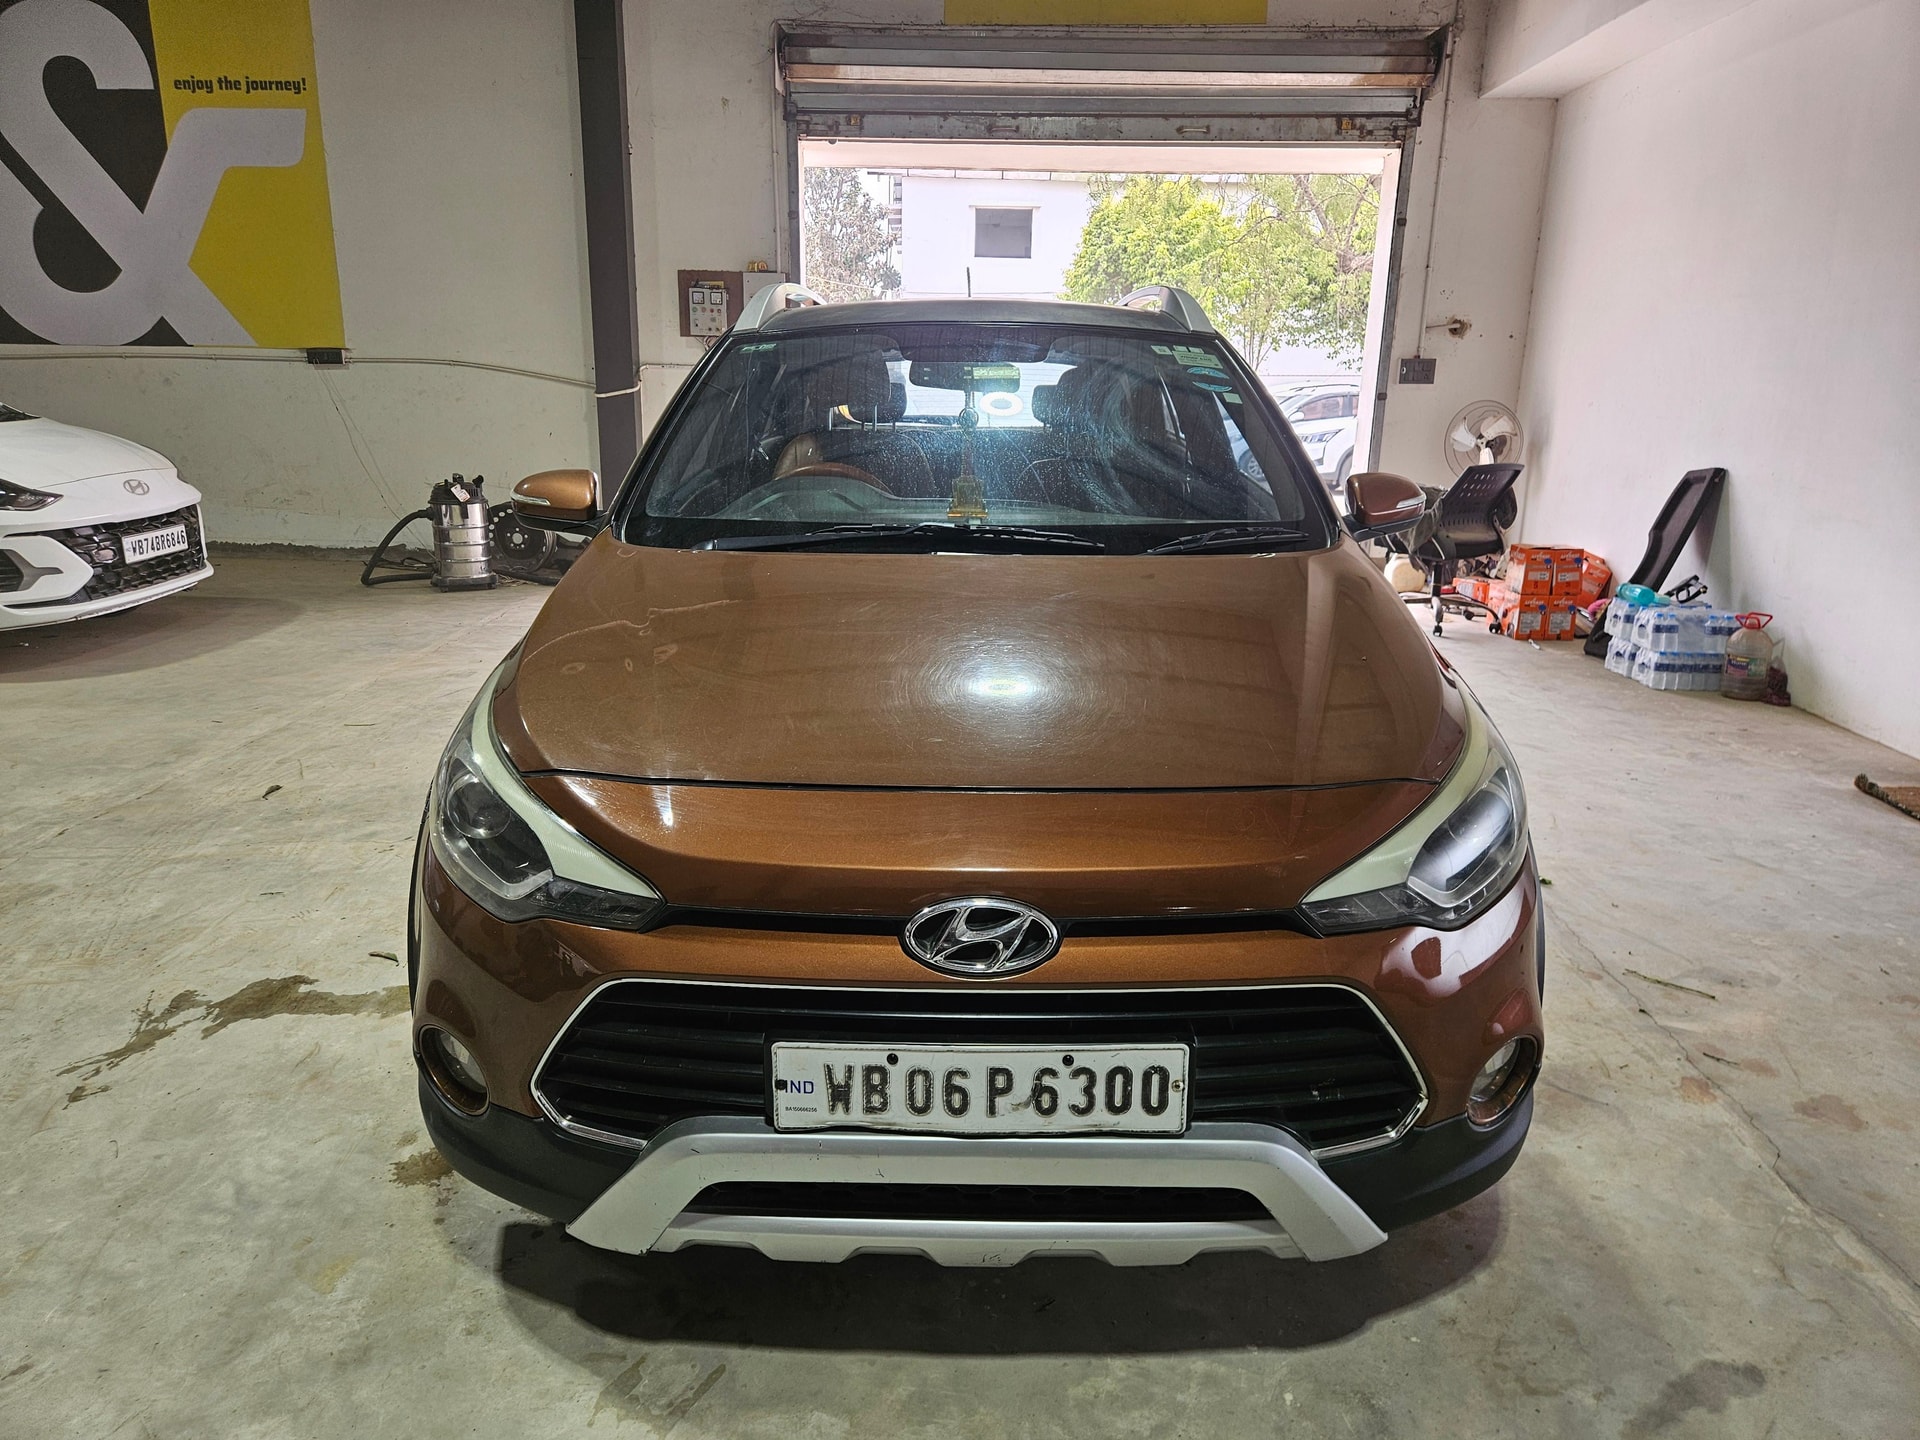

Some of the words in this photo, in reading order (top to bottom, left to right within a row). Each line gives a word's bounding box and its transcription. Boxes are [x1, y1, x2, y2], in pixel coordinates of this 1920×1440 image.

[173, 75, 214, 94] enjoy
[217, 75, 242, 91] the
[245, 76, 307, 95] journey!
[130, 529, 186, 557] WB74BR6846
[823, 1062, 891, 1116] WB
[904, 1065, 971, 1118] 06
[1031, 1065, 1171, 1118] 6300
